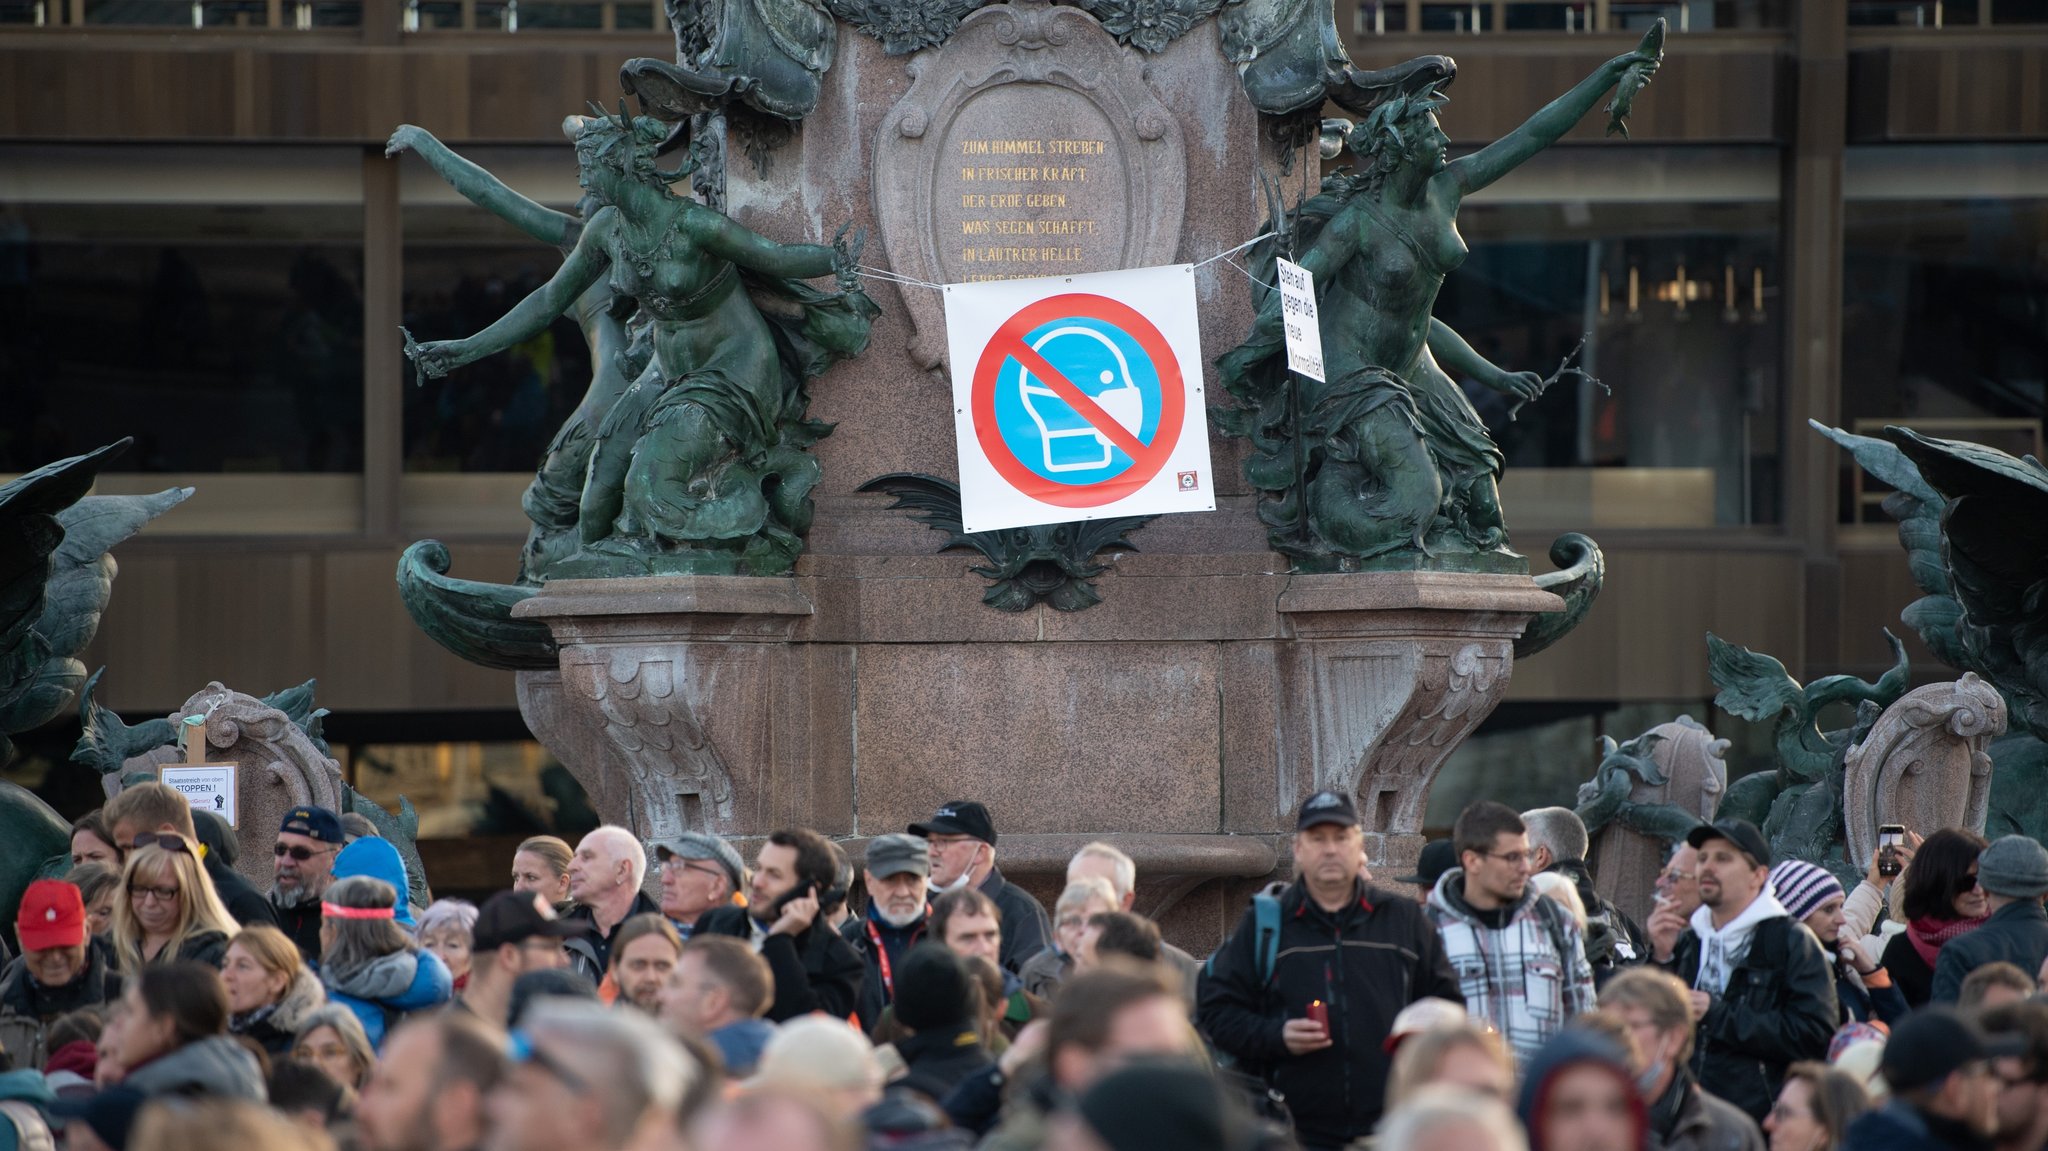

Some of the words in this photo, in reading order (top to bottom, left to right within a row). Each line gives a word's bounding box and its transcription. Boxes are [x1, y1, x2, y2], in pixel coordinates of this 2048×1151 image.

[962, 140, 988, 154] ZUM
[992, 140, 1045, 154] HIMMEL
[1050, 140, 1105, 154] STREBEN
[962, 167, 975, 181] IN
[978, 167, 1038, 181] FRISCHER
[962, 194, 986, 208] DER
[991, 194, 1023, 208] ERDE
[962, 220, 990, 235] WAS
[995, 220, 1034, 235] SEGEN
[963, 247, 976, 261] IN
[979, 247, 1037, 261] LAUTRER
[1042, 247, 1083, 261] HELLE
[1295, 272, 1305, 291] auf
[1283, 293, 1303, 316] gegen
[1303, 297, 1314, 318] die
[1287, 323, 1302, 342] neue
[175, 784, 211, 792] STOPPEN
